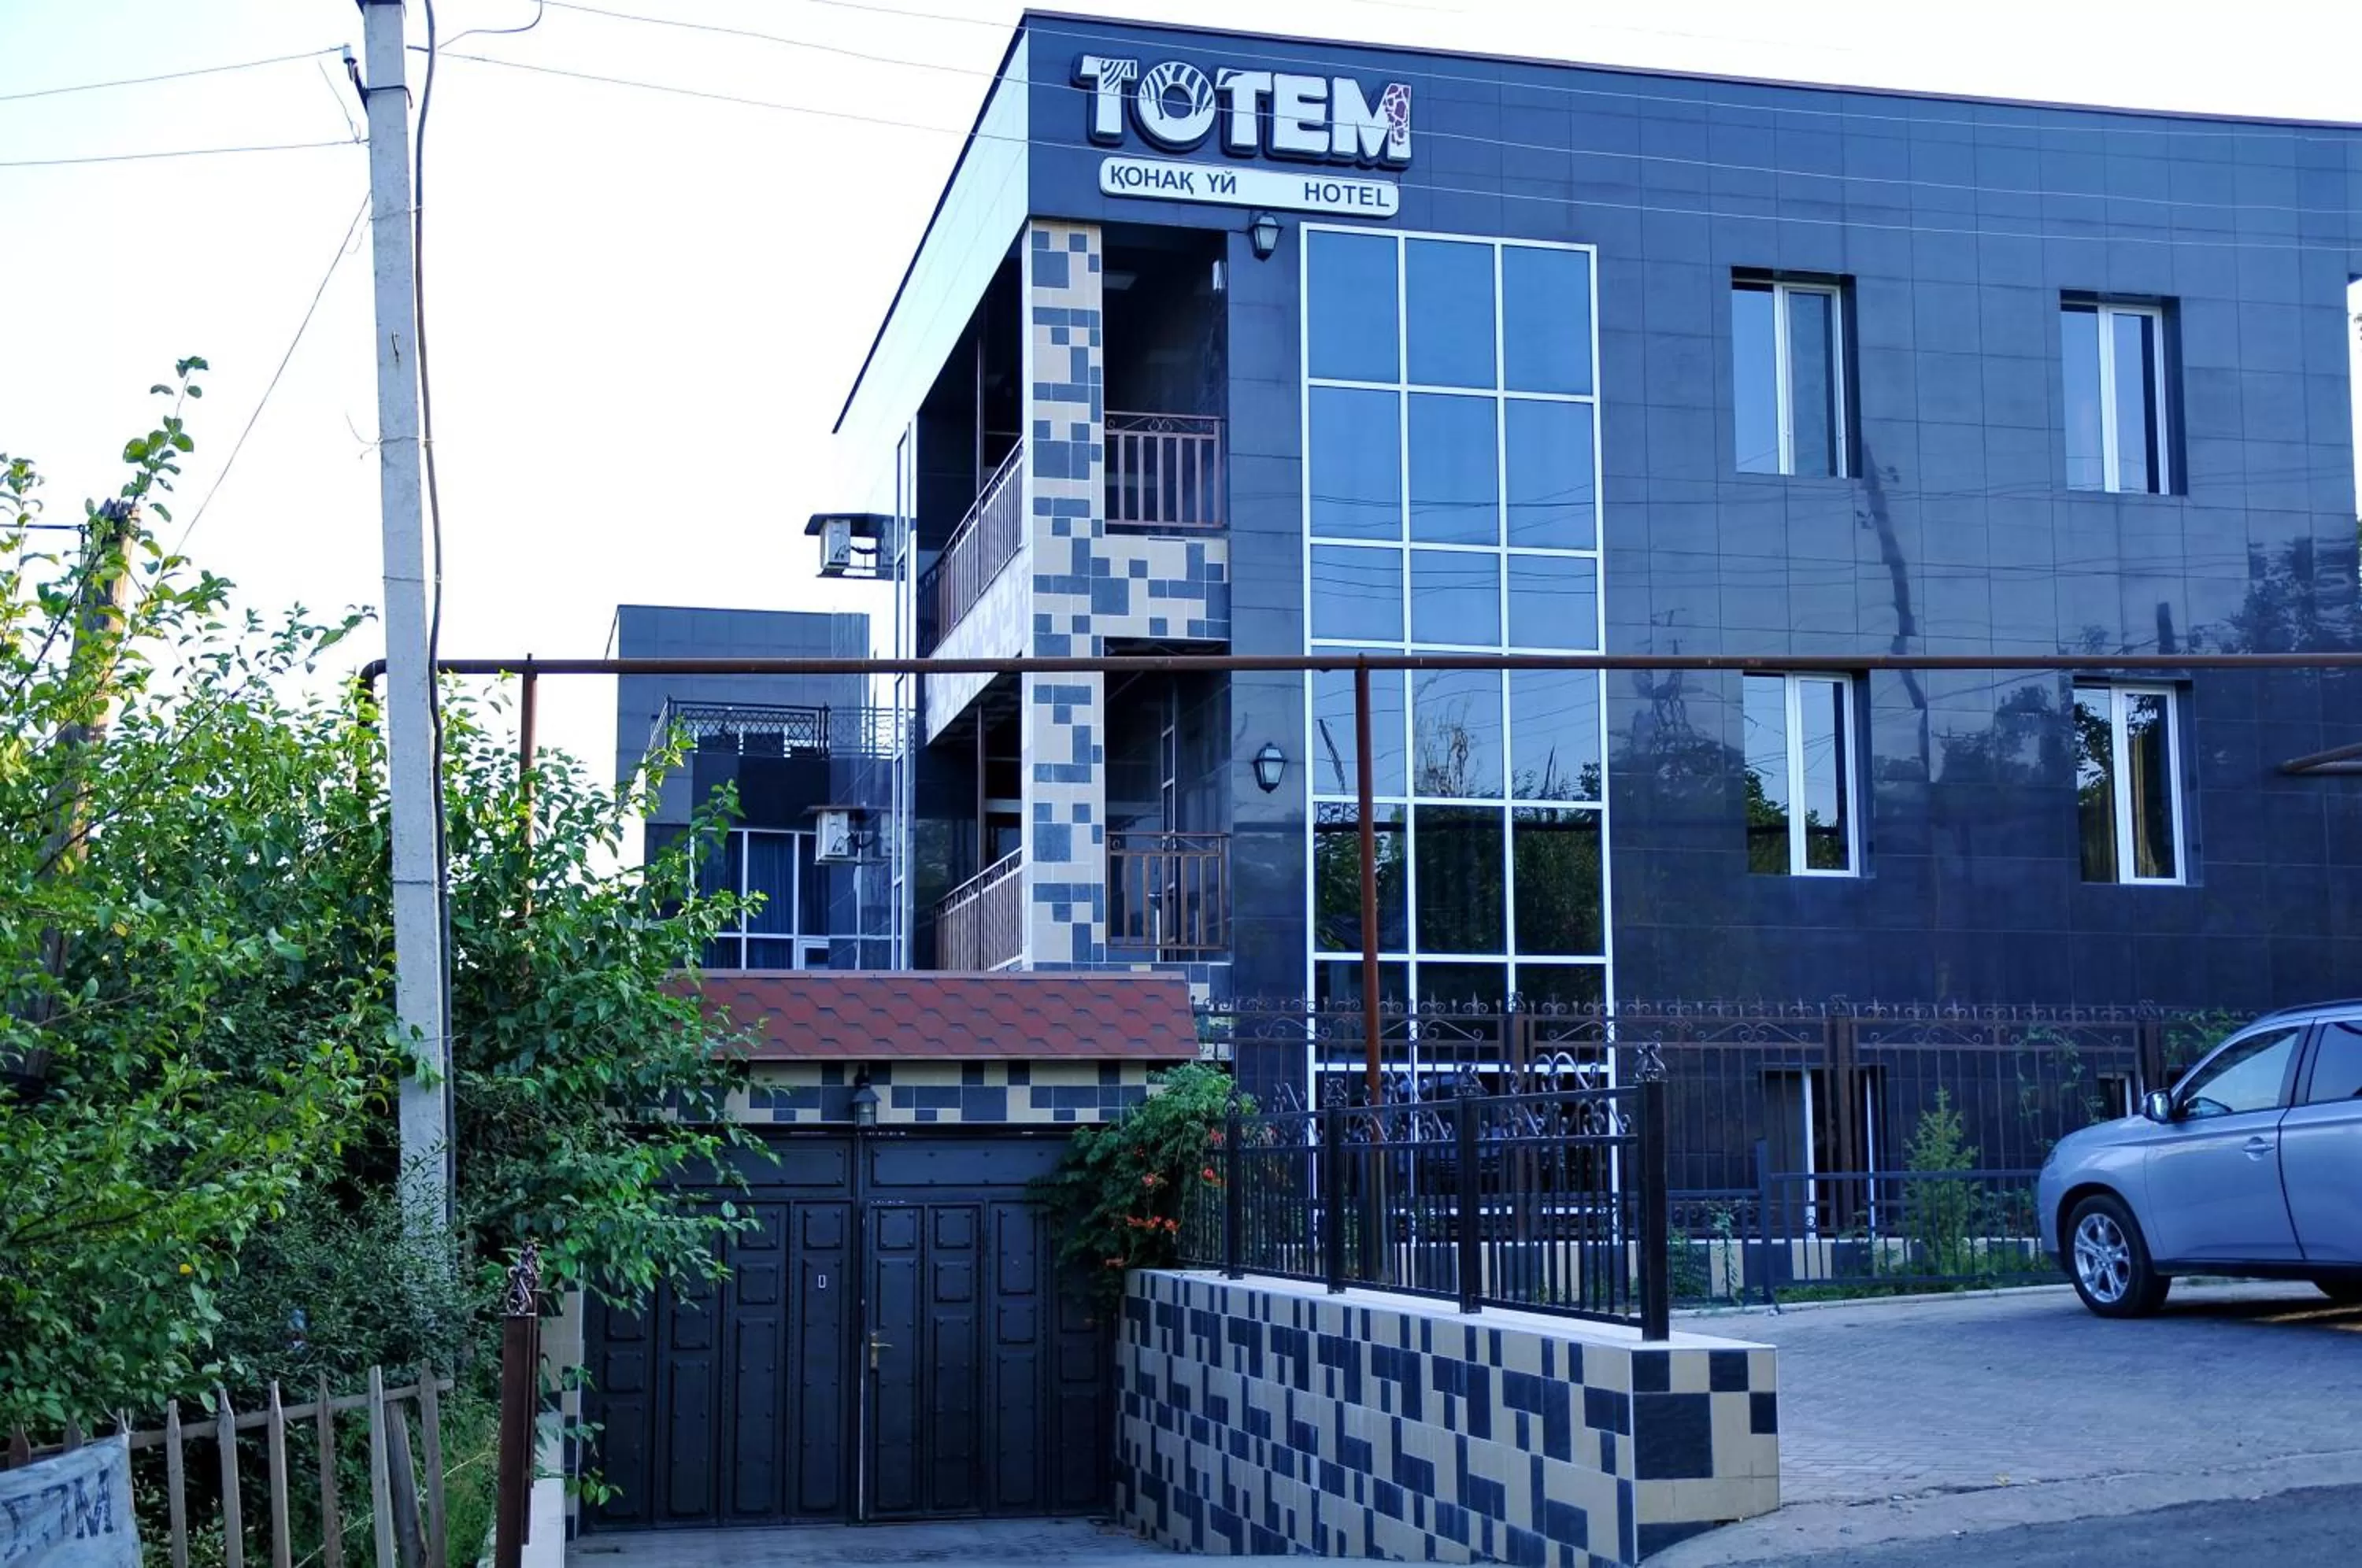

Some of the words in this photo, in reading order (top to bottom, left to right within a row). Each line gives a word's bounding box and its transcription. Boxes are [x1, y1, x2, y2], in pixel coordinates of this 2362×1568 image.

[1079, 54, 1412, 161] TOTEM
[1111, 165, 1194, 195] ҚОНАҚ
[1304, 182, 1390, 208] HOTEL
